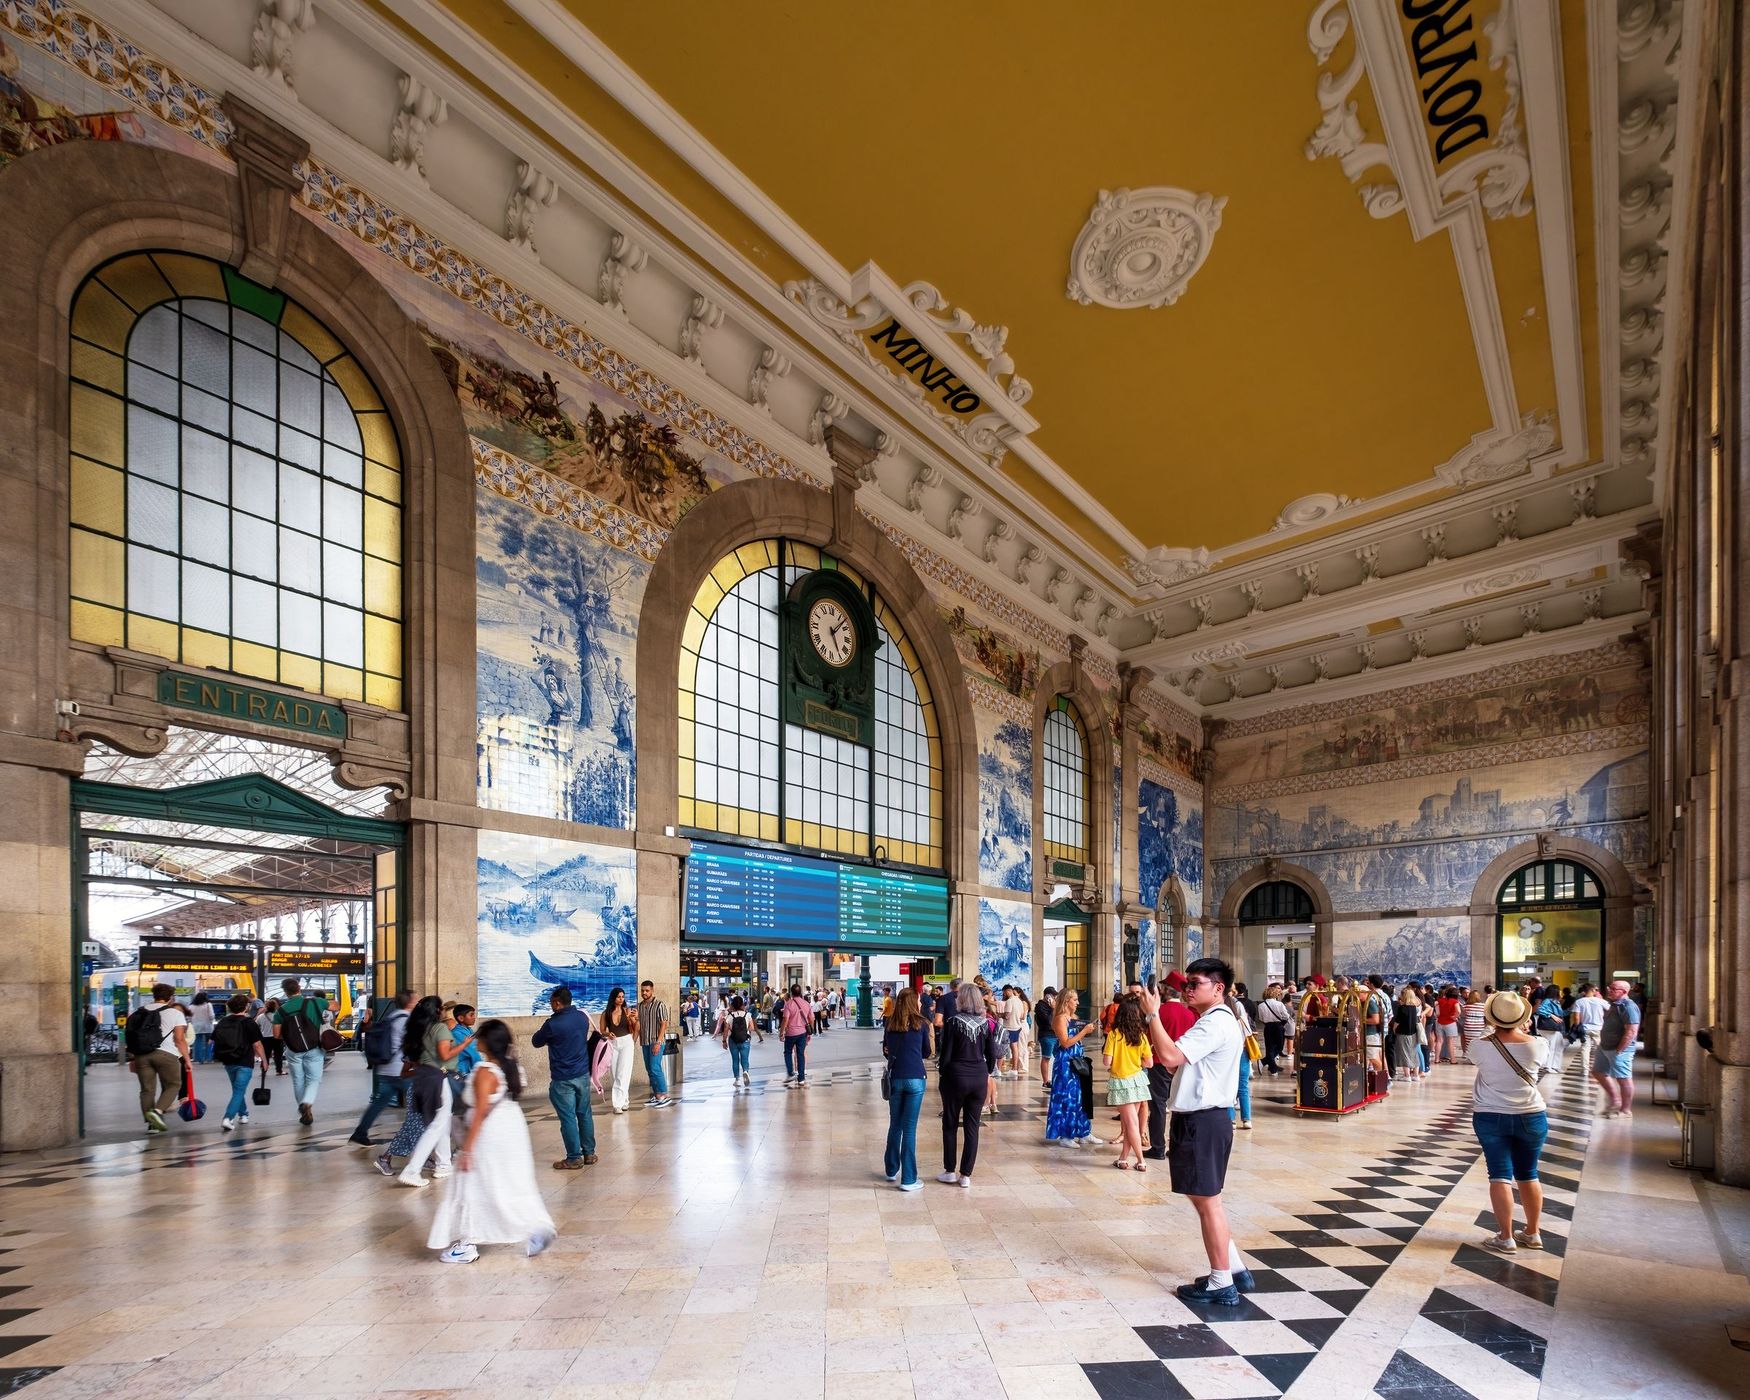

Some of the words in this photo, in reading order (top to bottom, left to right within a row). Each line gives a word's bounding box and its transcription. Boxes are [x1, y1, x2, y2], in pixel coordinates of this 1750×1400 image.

[870, 319, 980, 414] MINHO
[174, 677, 333, 731] ENTRADA
[767, 854, 792, 862] DEPARTURES
[1520, 945, 1574, 954] MOBILIDADE
